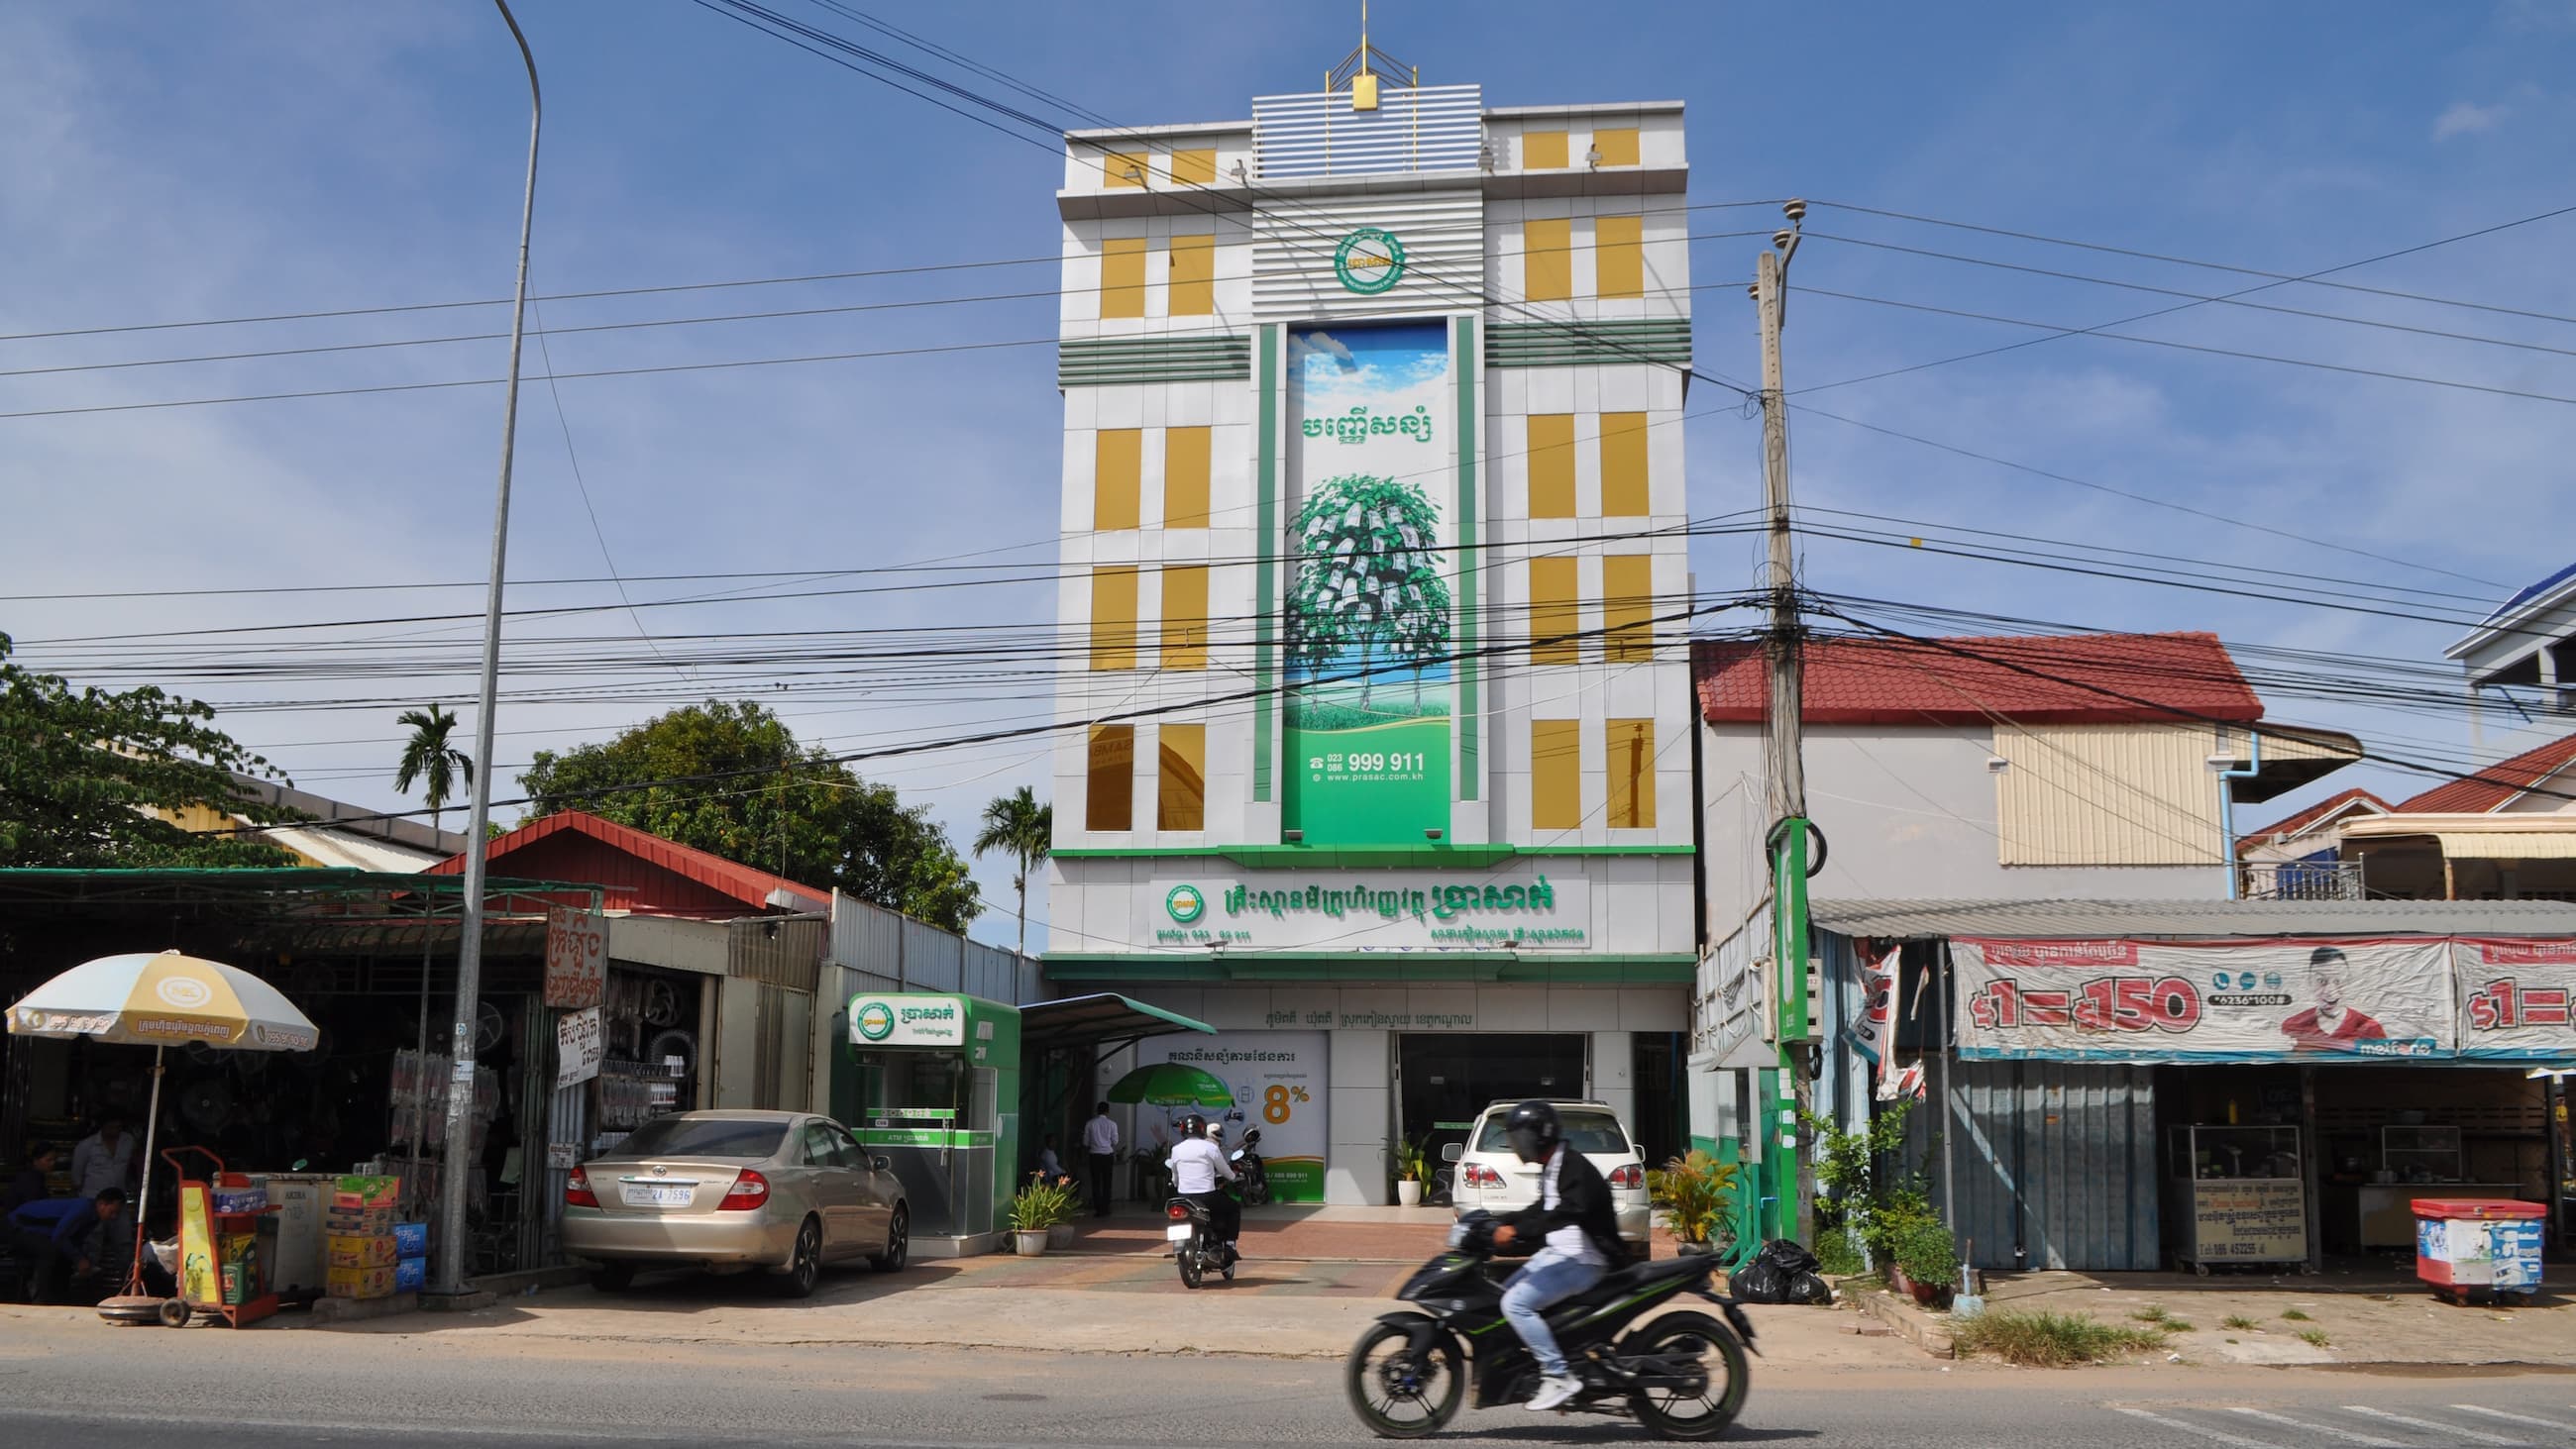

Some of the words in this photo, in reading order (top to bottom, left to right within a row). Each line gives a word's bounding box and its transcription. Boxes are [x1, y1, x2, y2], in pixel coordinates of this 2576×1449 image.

[1327, 754, 1343, 763] 023
[1327, 763, 1343, 773] 086
[1348, 753, 1384, 772] 999
[1390, 752, 1424, 772] 911
[1431, 875, 1555, 919] ប្រាសាក់
[1262, 1085, 1310, 1125] 8%
